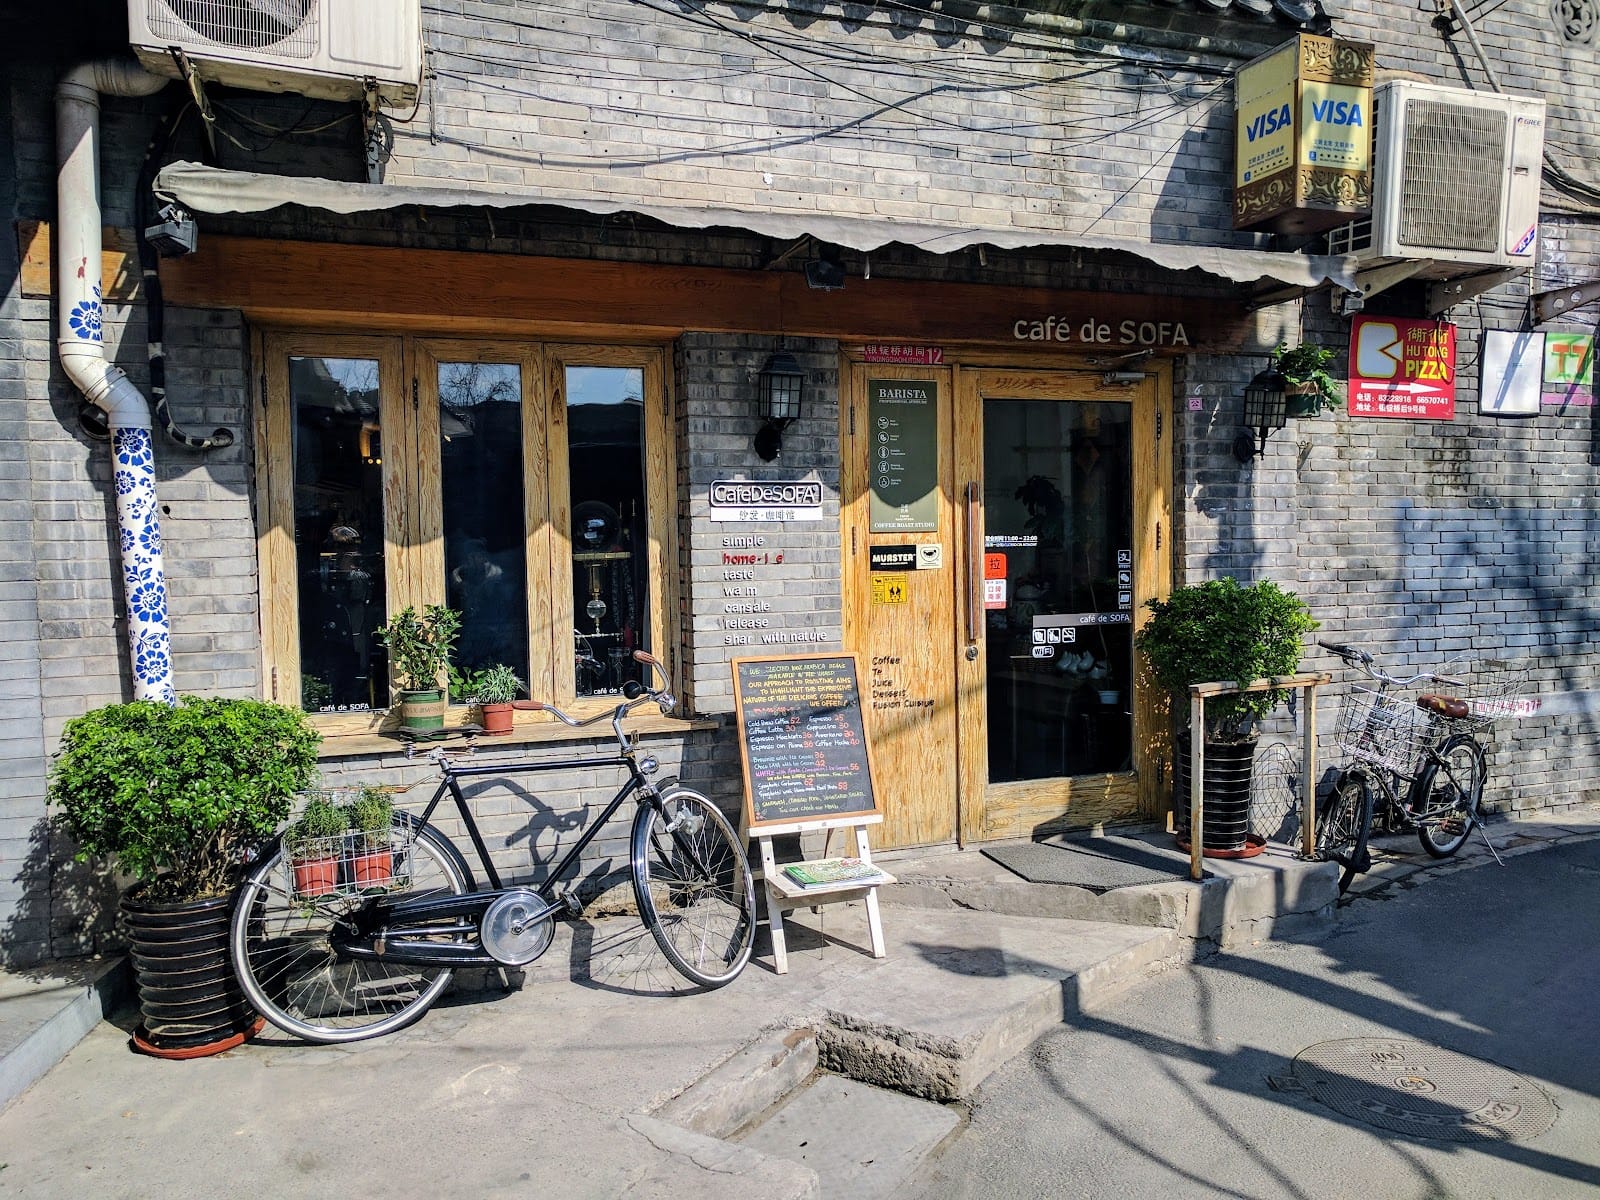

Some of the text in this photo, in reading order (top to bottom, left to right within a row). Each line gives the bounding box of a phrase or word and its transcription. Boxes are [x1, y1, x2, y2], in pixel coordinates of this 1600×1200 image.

[1312, 99, 1363, 127] VISA
[1246, 103, 1291, 143] VISA
[1523, 118, 1543, 126] GREE
[1013, 316, 1189, 345] café de SOFA
[926, 347, 943, 365] 12
[1406, 344, 1449, 359] HU TONG
[1405, 360, 1448, 379] PIZZA
[879, 388, 927, 398] BARISTA
[723, 534, 765, 549] simple
[724, 568, 754, 580] taste
[725, 617, 769, 629] release
[1080, 613, 1130, 623] café de SOFA
[761, 631, 787, 644] with
[790, 630, 827, 643] nature
[872, 656, 900, 665] Coffee
[764, 679, 793, 687] APPROACH
[743, 696, 766, 704] NATURE
[873, 699, 934, 709] Fusion Cuisine
